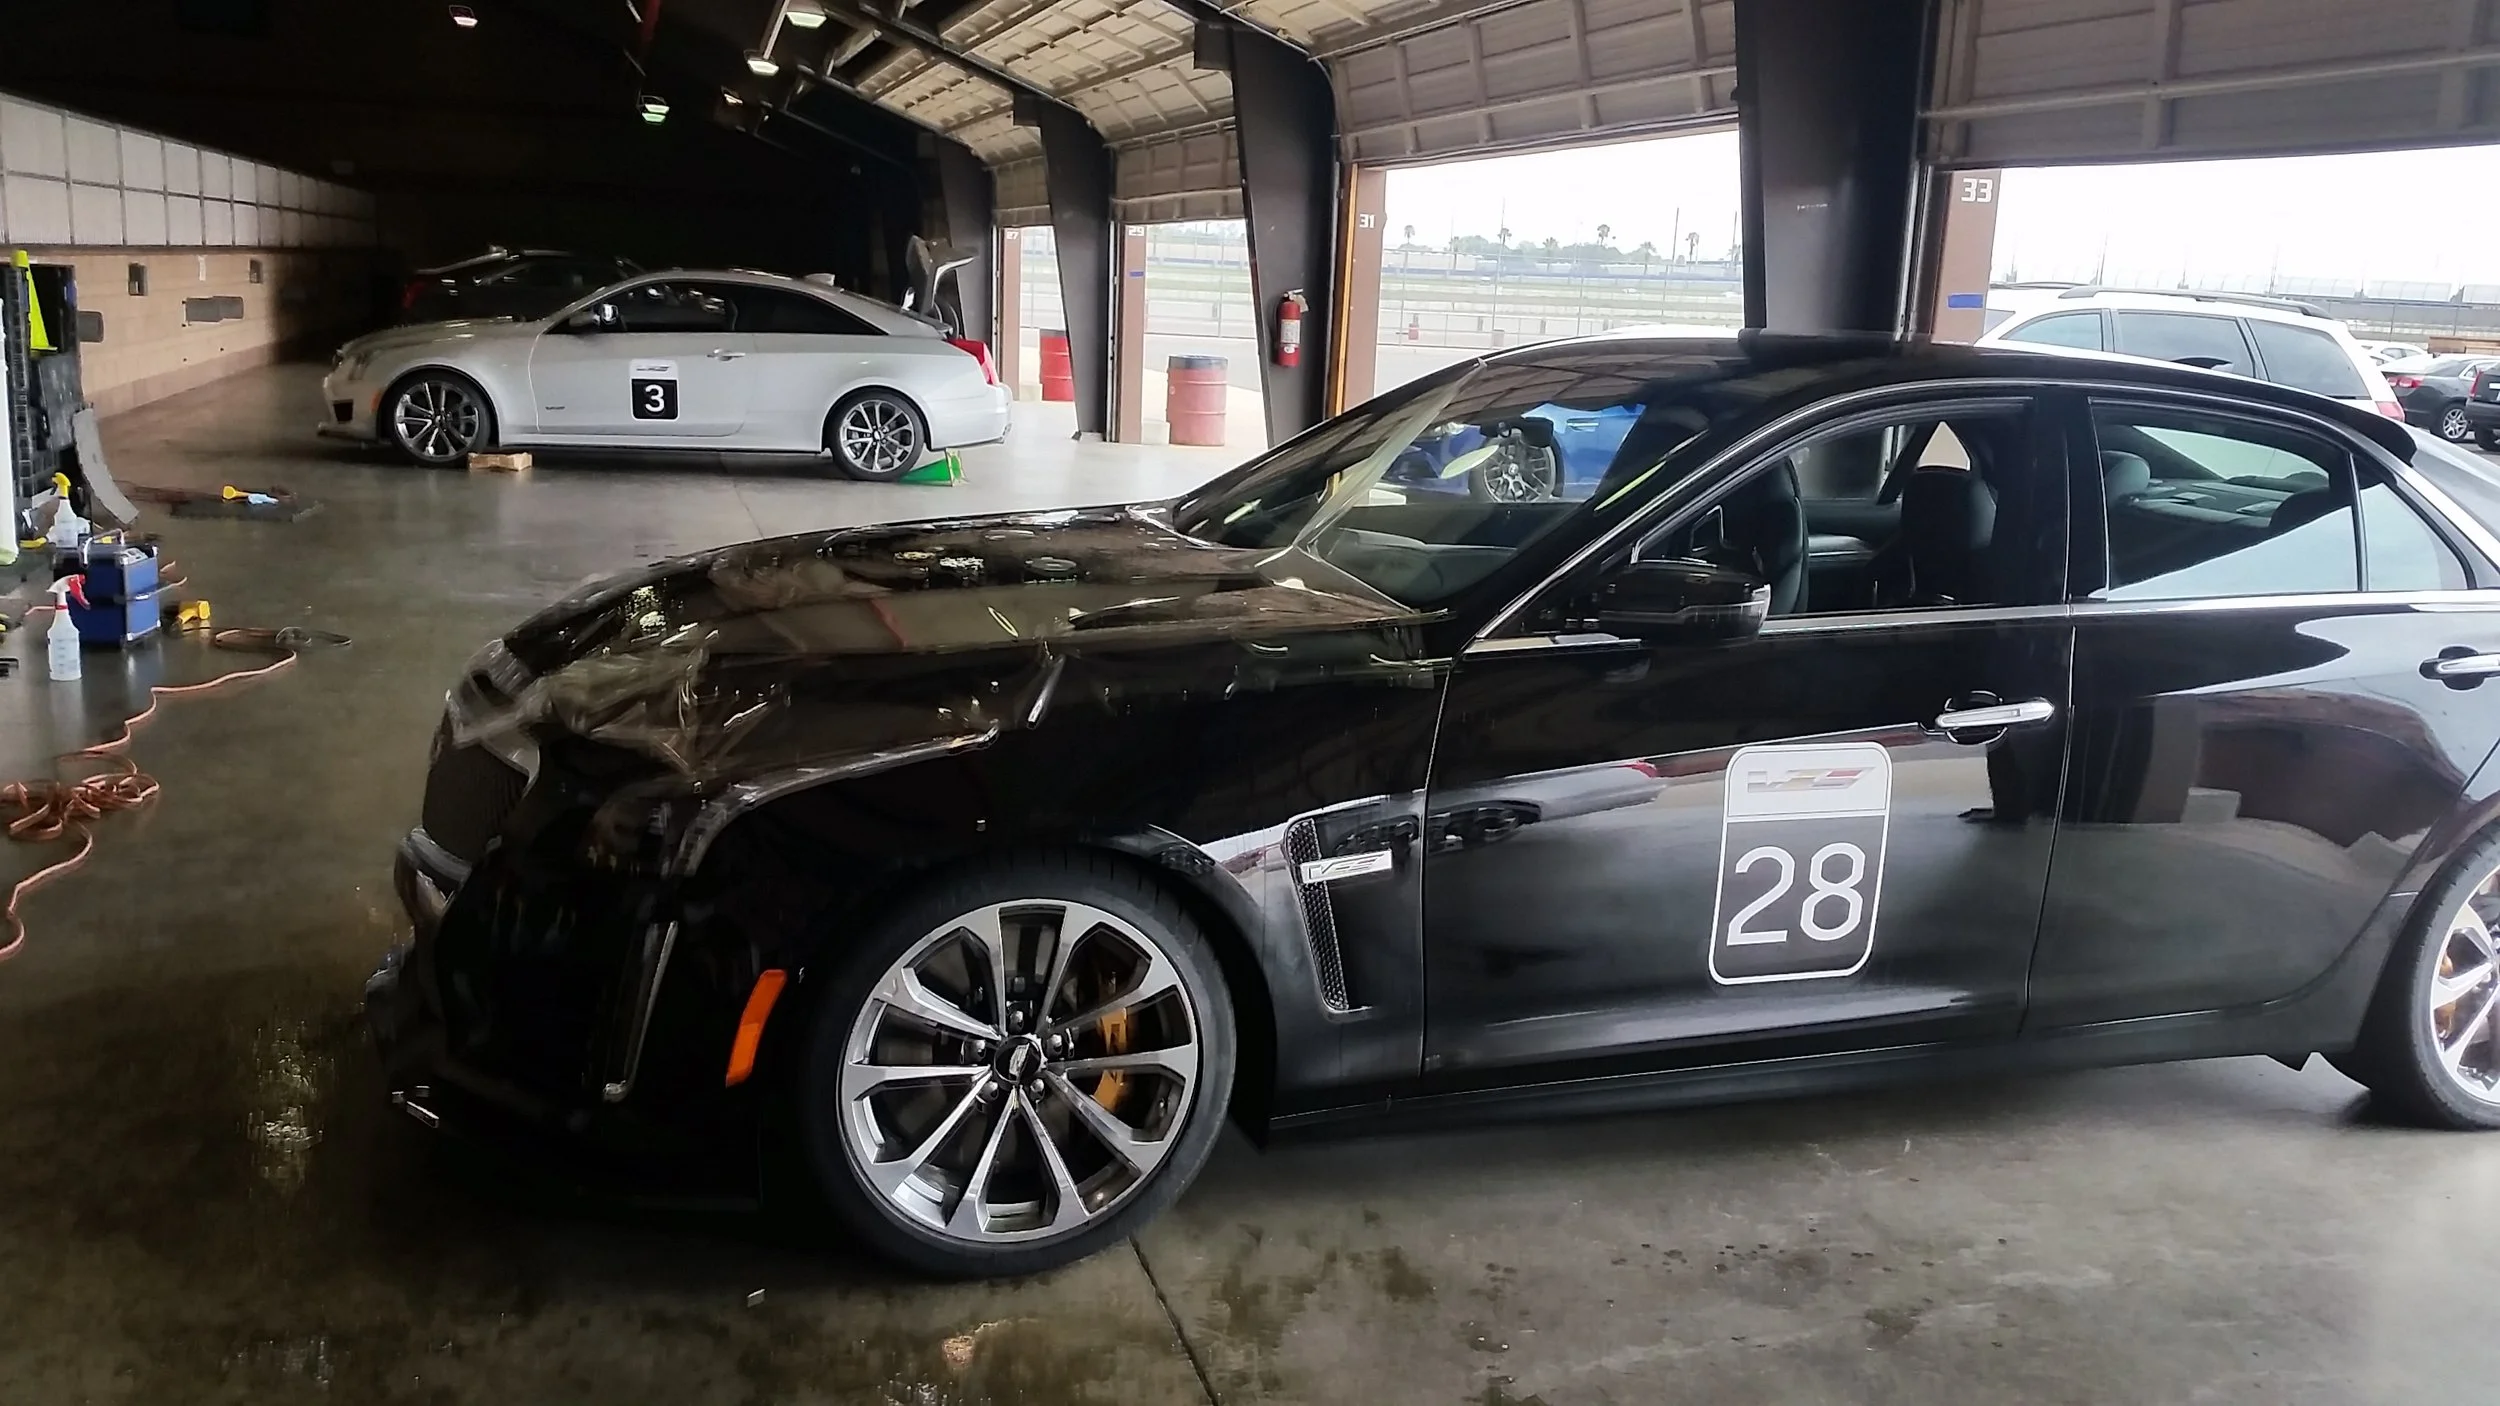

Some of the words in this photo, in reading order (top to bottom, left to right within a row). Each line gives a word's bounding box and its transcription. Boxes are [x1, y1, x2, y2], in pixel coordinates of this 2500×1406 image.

[1961, 178, 1993, 202] 33
[1128, 225, 1145, 236] 29
[1359, 213, 1375, 228] 31
[645, 384, 665, 412] 3
[1727, 843, 1866, 946] 28
